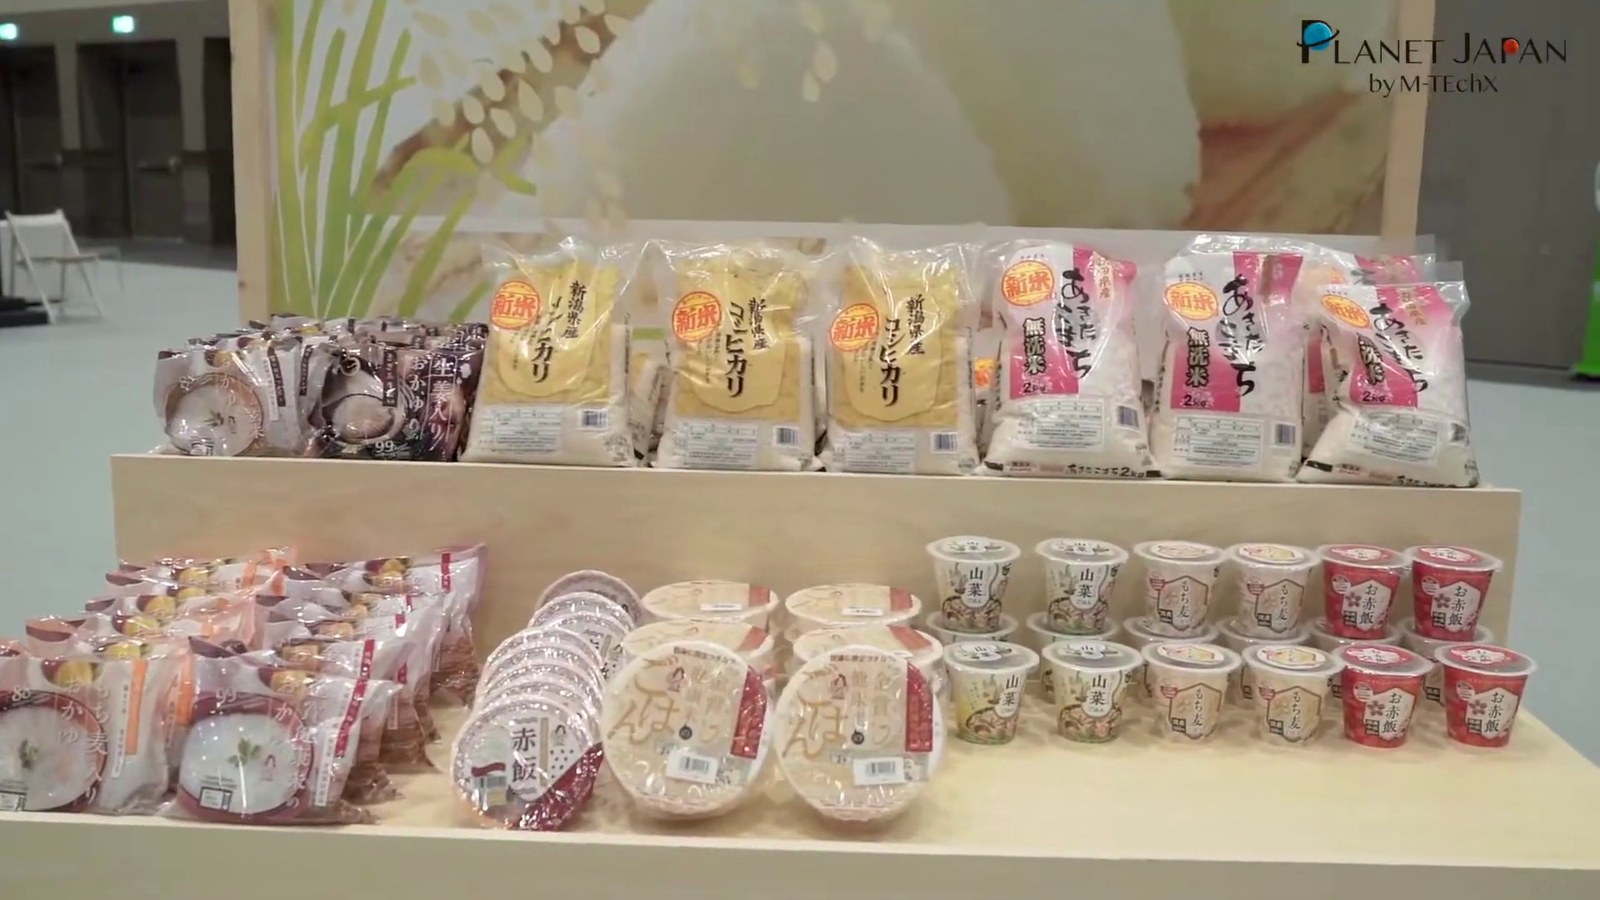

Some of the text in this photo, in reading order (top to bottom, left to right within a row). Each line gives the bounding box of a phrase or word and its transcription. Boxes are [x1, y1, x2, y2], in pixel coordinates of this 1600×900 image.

[493, 293, 537, 317] 新米
[1005, 273, 1051, 298] 新米
[565, 280, 589, 339] 新潟県産
[676, 304, 719, 335] 新米
[833, 315, 876, 340] 新米
[906, 293, 925, 355] 新潟県産
[725, 301, 748, 398] コシヒカリ
[880, 317, 905, 407] コシヒカリ
[1023, 317, 1046, 375] 無洗米
[1185, 327, 1210, 388] 無洗米
[431, 357, 455, 440] 生姜入り
[375, 441, 395, 452] 99
[968, 566, 985, 598] 山菜
[1078, 568, 1094, 598] 山菜
[1359, 583, 1378, 625] お赤飯
[1448, 585, 1468, 626] お赤飯
[1002, 675, 1019, 707] 山菜
[1090, 675, 1107, 706] 山菜
[1381, 693, 1402, 733] お赤飯
[1485, 692, 1504, 733] お赤飯
[512, 727, 538, 783] 赤飯
